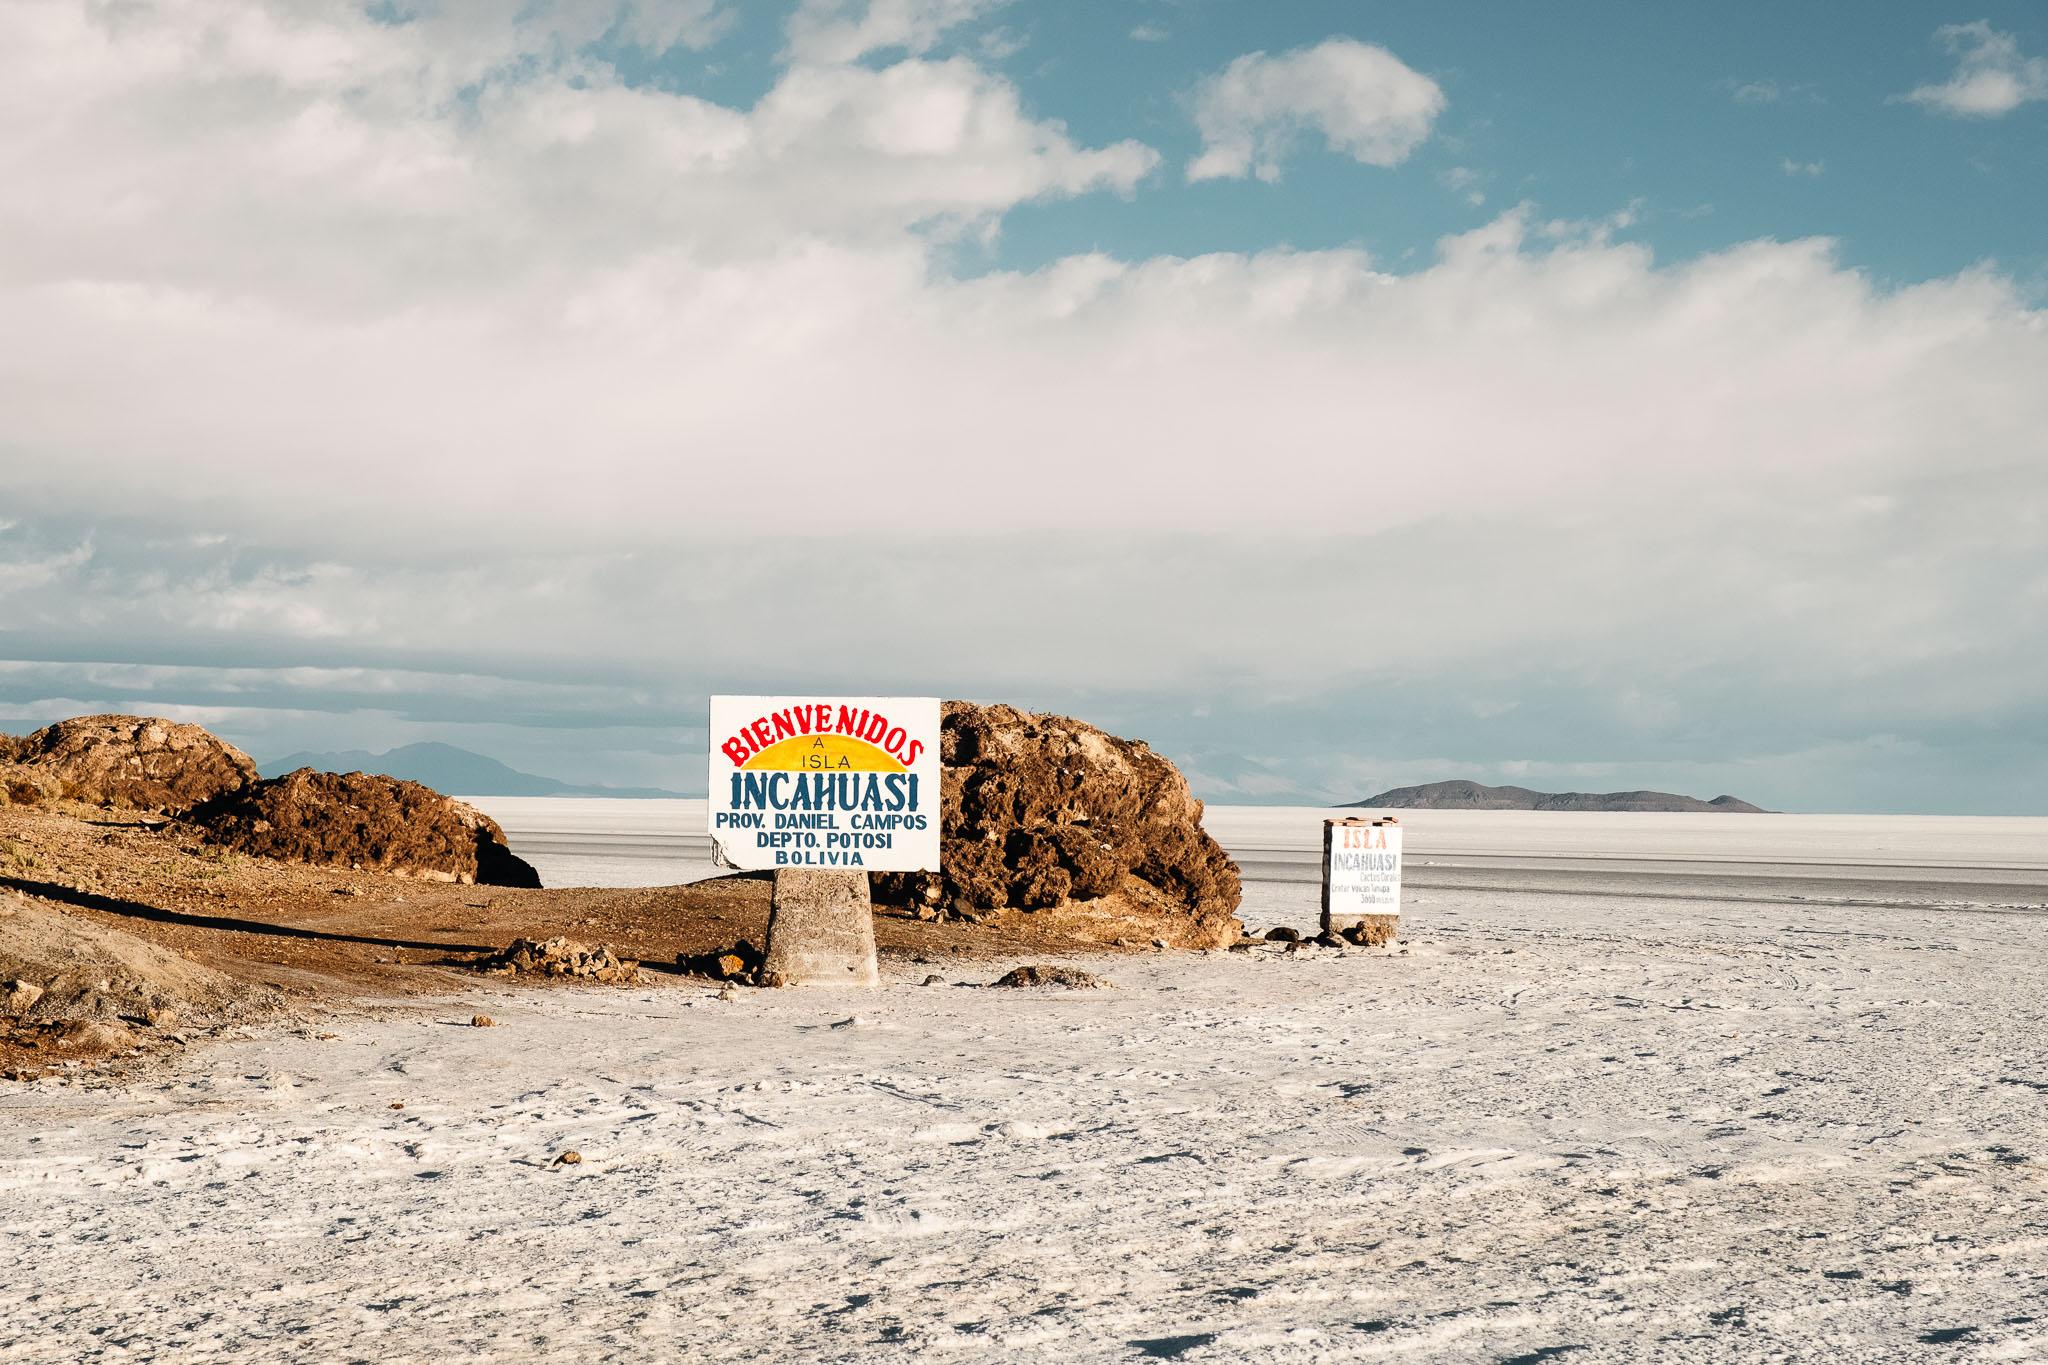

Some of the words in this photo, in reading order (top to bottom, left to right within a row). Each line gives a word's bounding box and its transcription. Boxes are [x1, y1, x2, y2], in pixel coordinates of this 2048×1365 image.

[721, 704, 925, 767] BIENVENIDOS
[812, 737, 825, 749] A
[802, 754, 851, 769] ISLA
[730, 772, 919, 811] INCAHUASI
[716, 812, 766, 829] PROV.
[775, 813, 840, 830] DANIEL
[850, 814, 928, 831] CAMPOS
[756, 832, 821, 849] DEPTO.
[826, 832, 892, 849] POTOSI
[1343, 828, 1388, 849] ISLA
[775, 850, 864, 866] BOLIVIA
[1334, 852, 1397, 872] INCAHUASI
